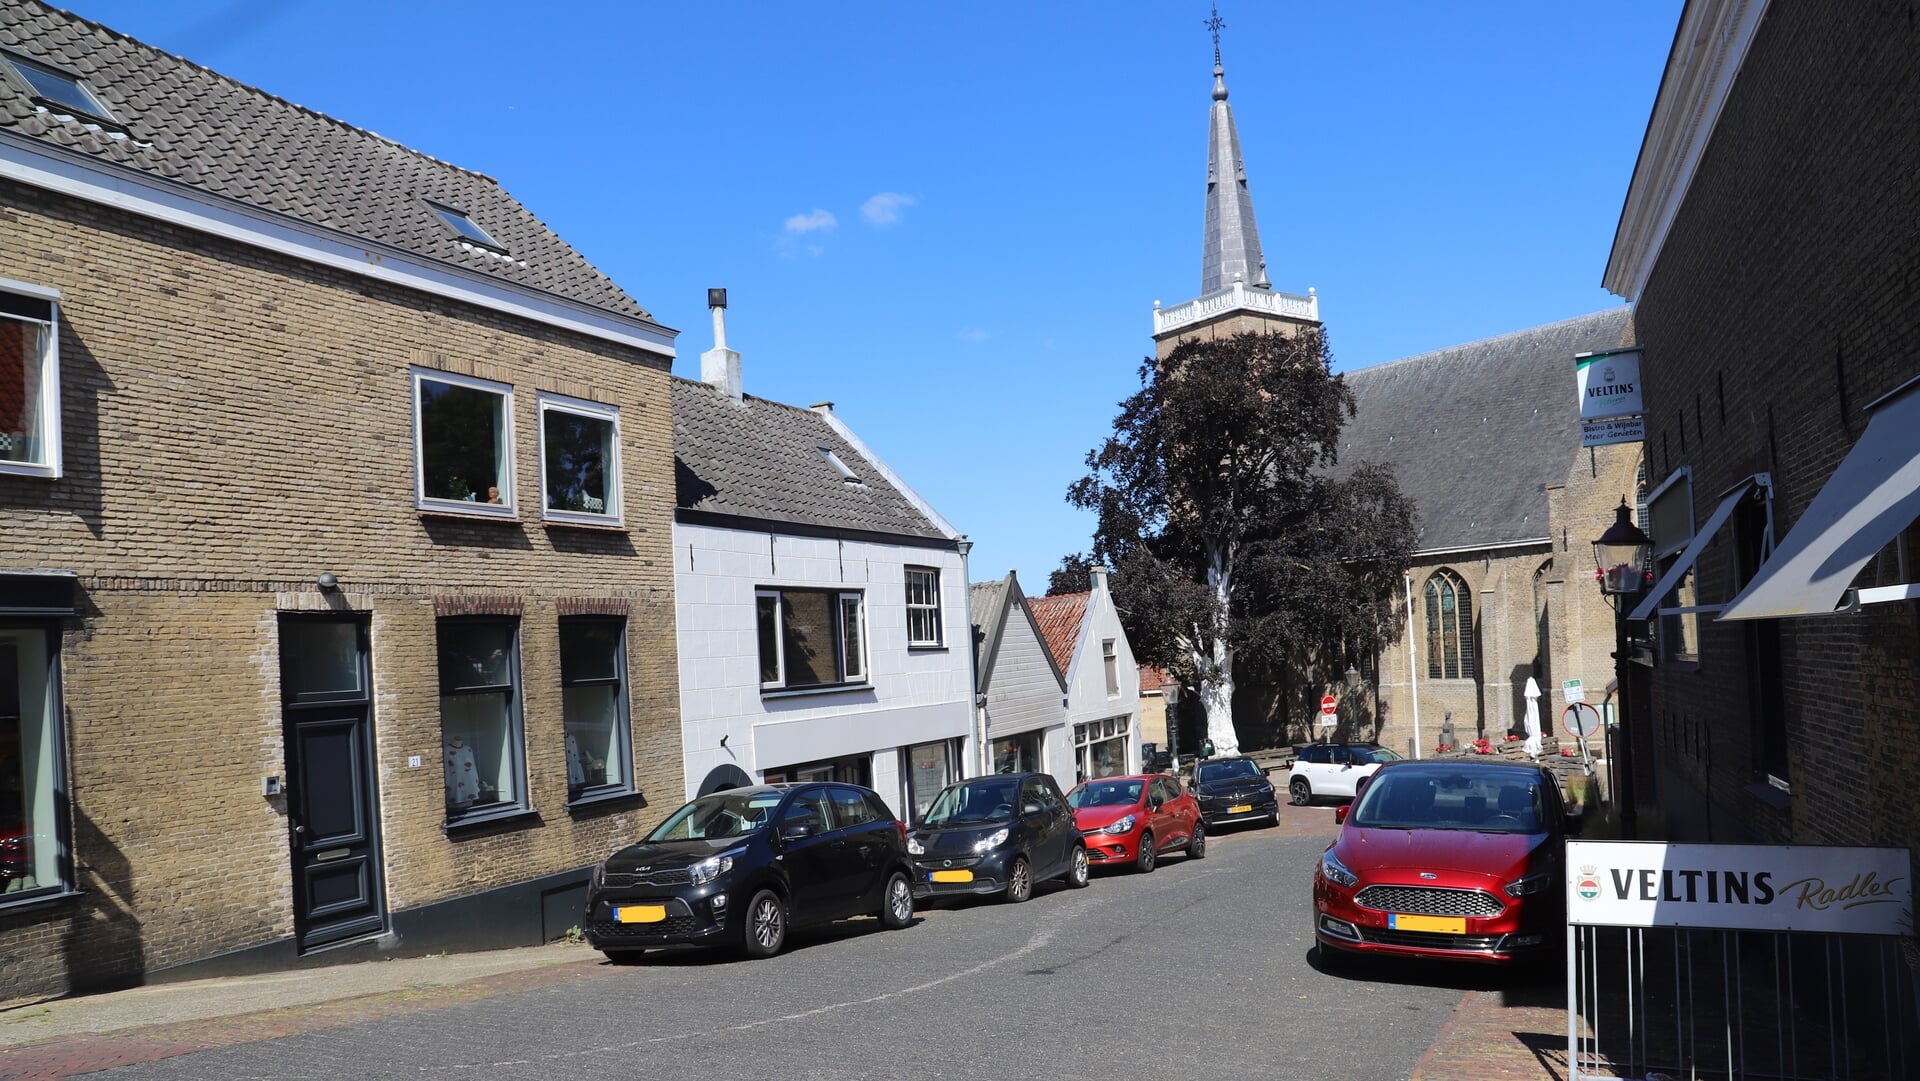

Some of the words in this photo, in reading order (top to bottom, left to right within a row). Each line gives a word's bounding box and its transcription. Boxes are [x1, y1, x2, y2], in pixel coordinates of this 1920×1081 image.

[1588, 383, 1634, 398] VELTINS
[1614, 421, 1642, 430] Wijnbar
[1584, 433, 1606, 441] Meer
[1607, 430, 1643, 438] Genieten
[411, 758, 419, 767] 21
[1610, 868, 1774, 905] VELTINS
[1778, 871, 1906, 911] Radler
